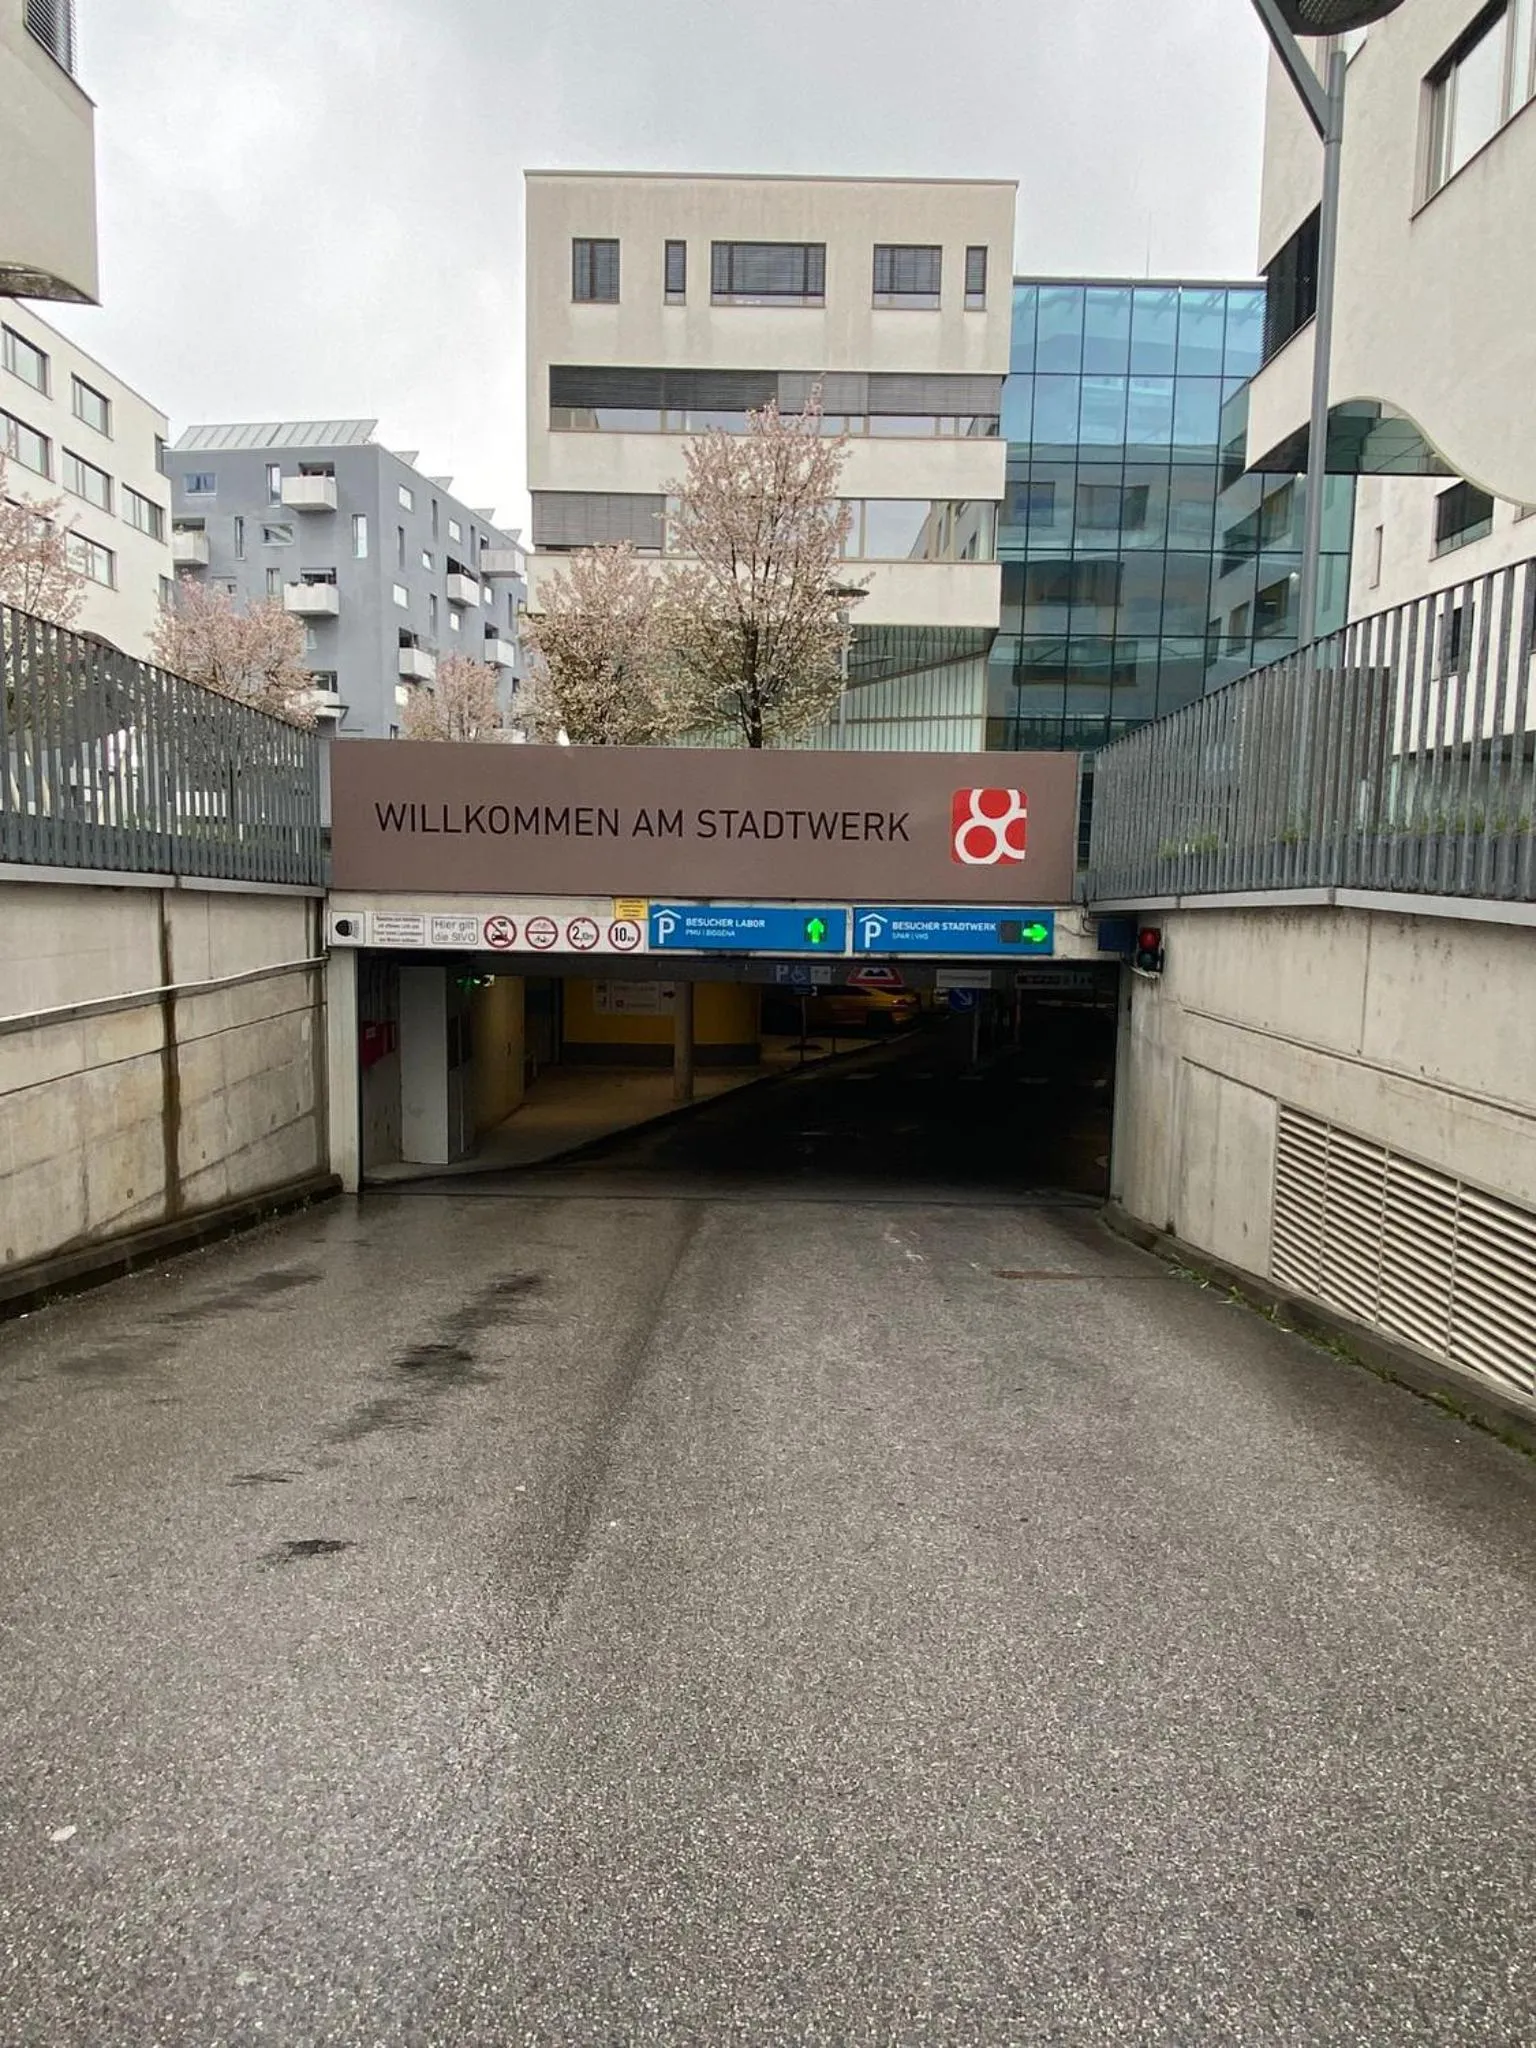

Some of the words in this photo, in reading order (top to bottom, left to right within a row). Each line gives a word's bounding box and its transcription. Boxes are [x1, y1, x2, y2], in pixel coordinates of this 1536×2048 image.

[375, 802, 619, 837] WILLKOMMEN
[632, 808, 684, 837] AM
[696, 809, 910, 842] STADTWERK
[435, 919, 457, 930] Hier
[459, 919, 474, 932] gilt
[685, 918, 734, 928] BESUCHER
[735, 919, 765, 928] LABOR
[892, 921, 939, 931] BESUCHER
[942, 922, 996, 931] STADTWERK
[434, 931, 449, 941] die
[658, 917, 675, 944] P
[864, 920, 882, 948] P
